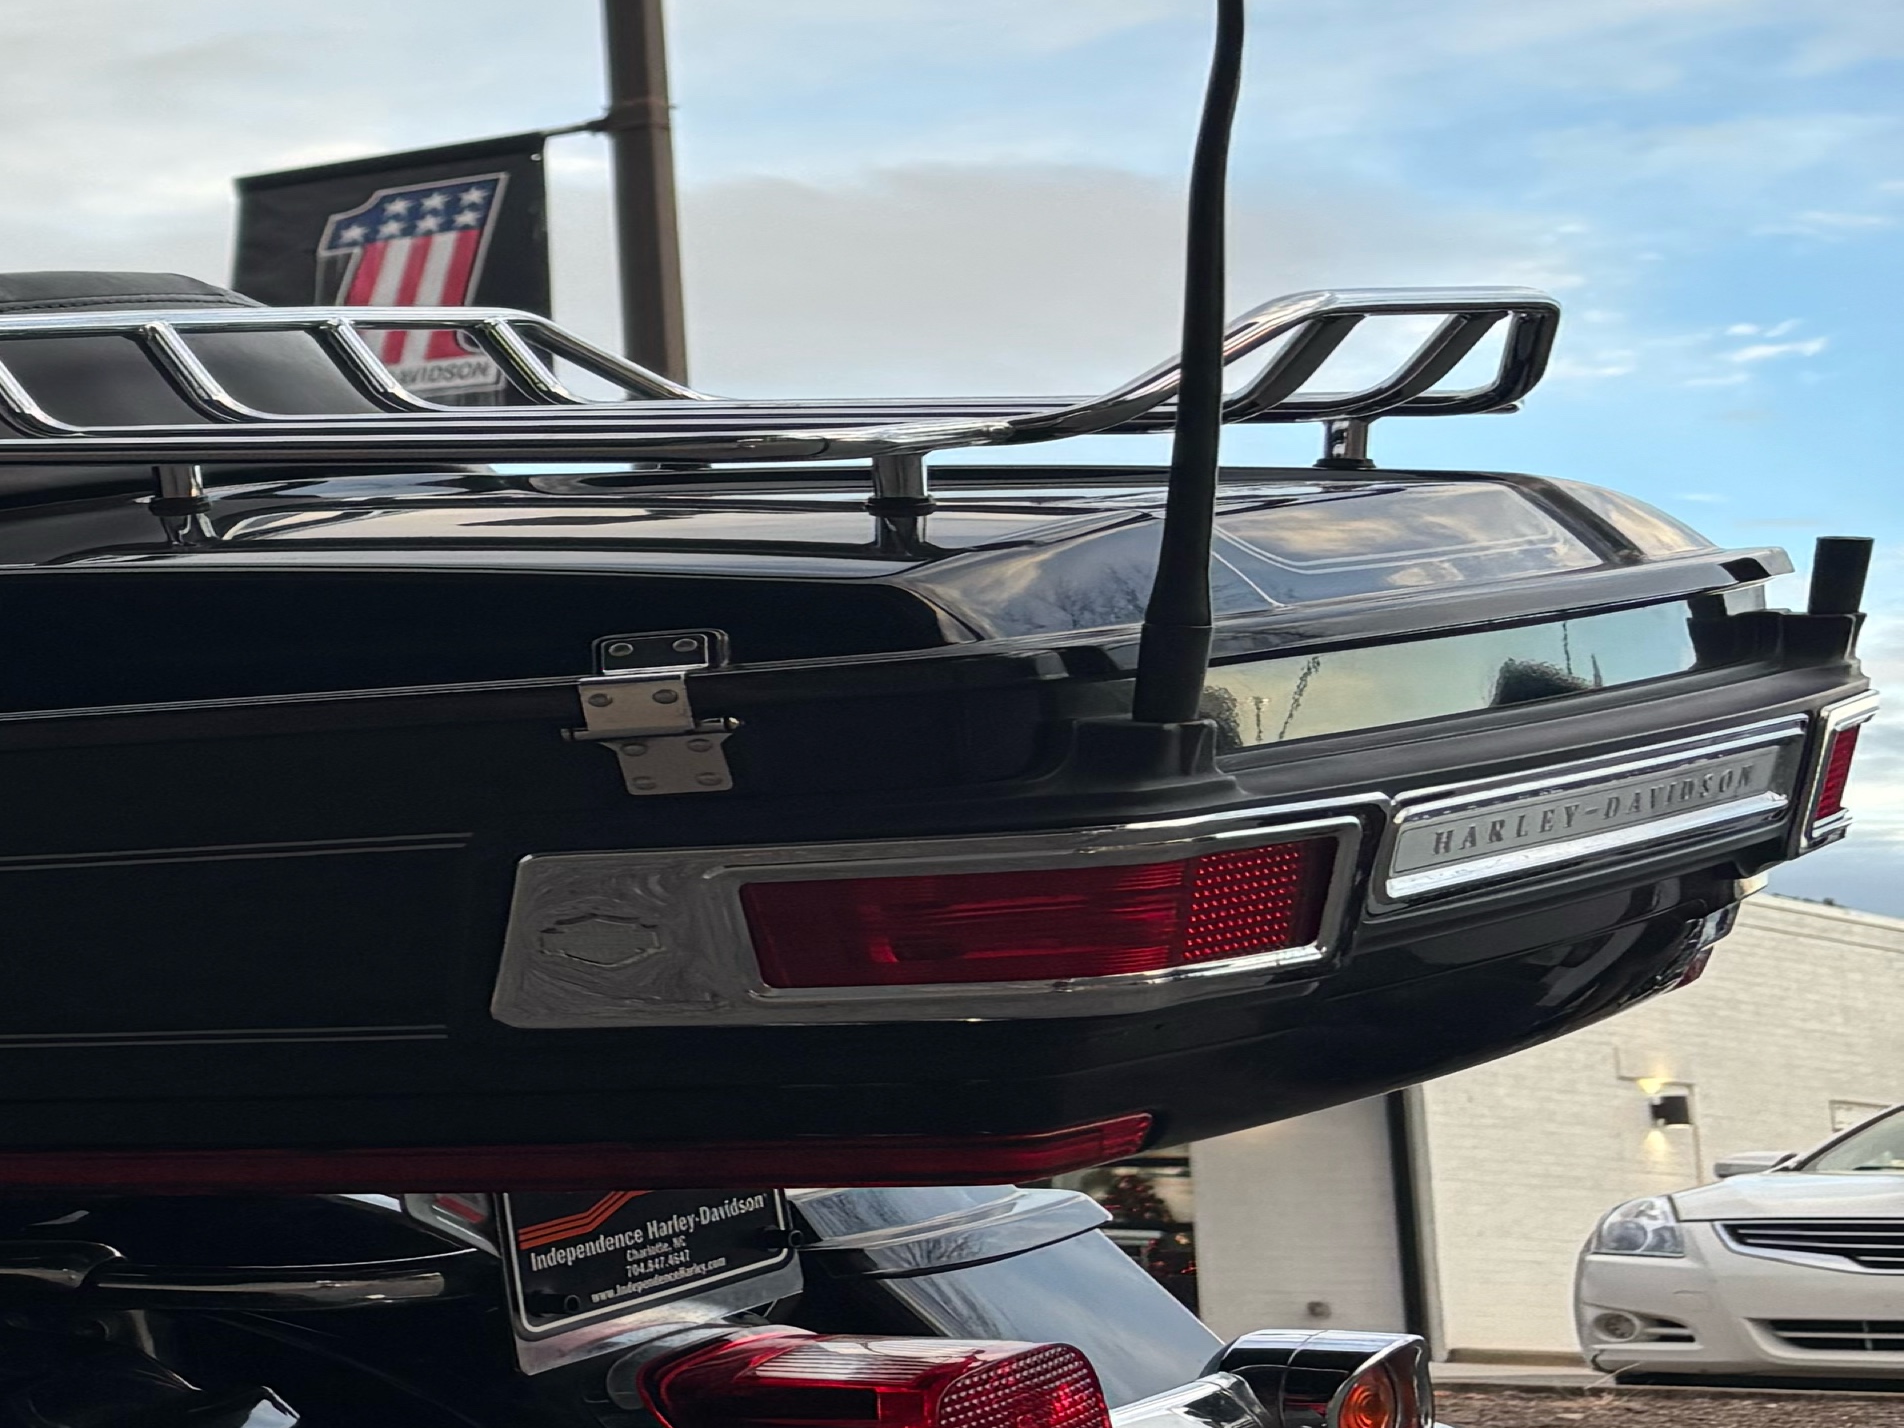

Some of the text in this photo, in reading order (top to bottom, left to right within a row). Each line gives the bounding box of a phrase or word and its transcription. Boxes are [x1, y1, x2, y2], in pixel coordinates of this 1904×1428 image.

[1431, 764, 1755, 856] HARLEY-DAVIDSON
[530, 1194, 766, 1272] Independence Harley-Davidson
[626, 1235, 687, 1262] Charlotte, NC
